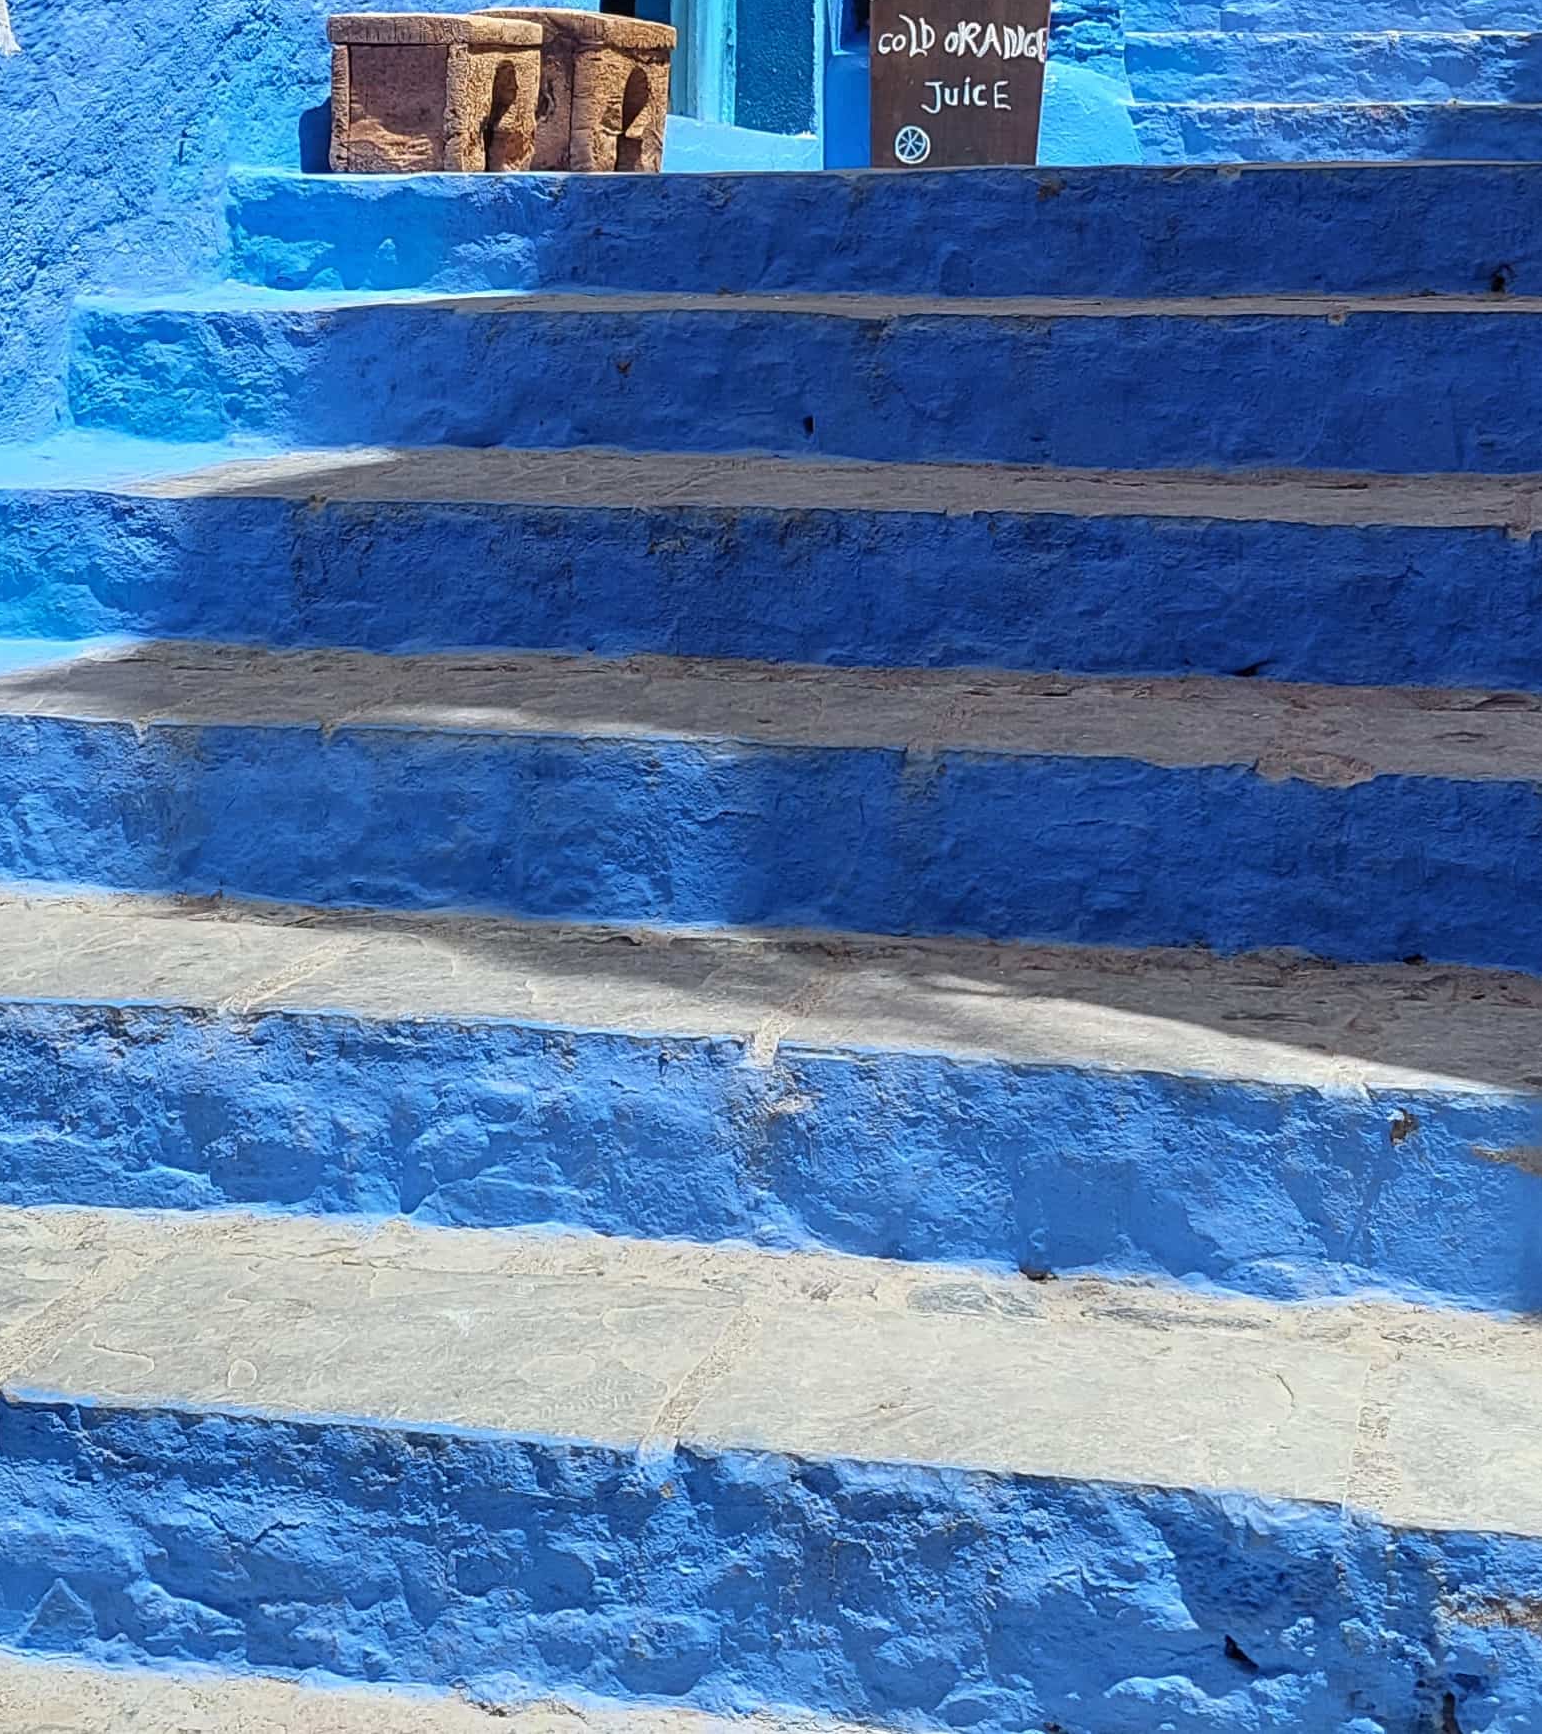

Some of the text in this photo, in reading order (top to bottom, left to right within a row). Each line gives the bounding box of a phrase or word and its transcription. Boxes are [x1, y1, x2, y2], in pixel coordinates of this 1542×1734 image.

[877, 14, 1049, 64] COLD ORANGE
[920, 76, 1012, 114] JUICE
